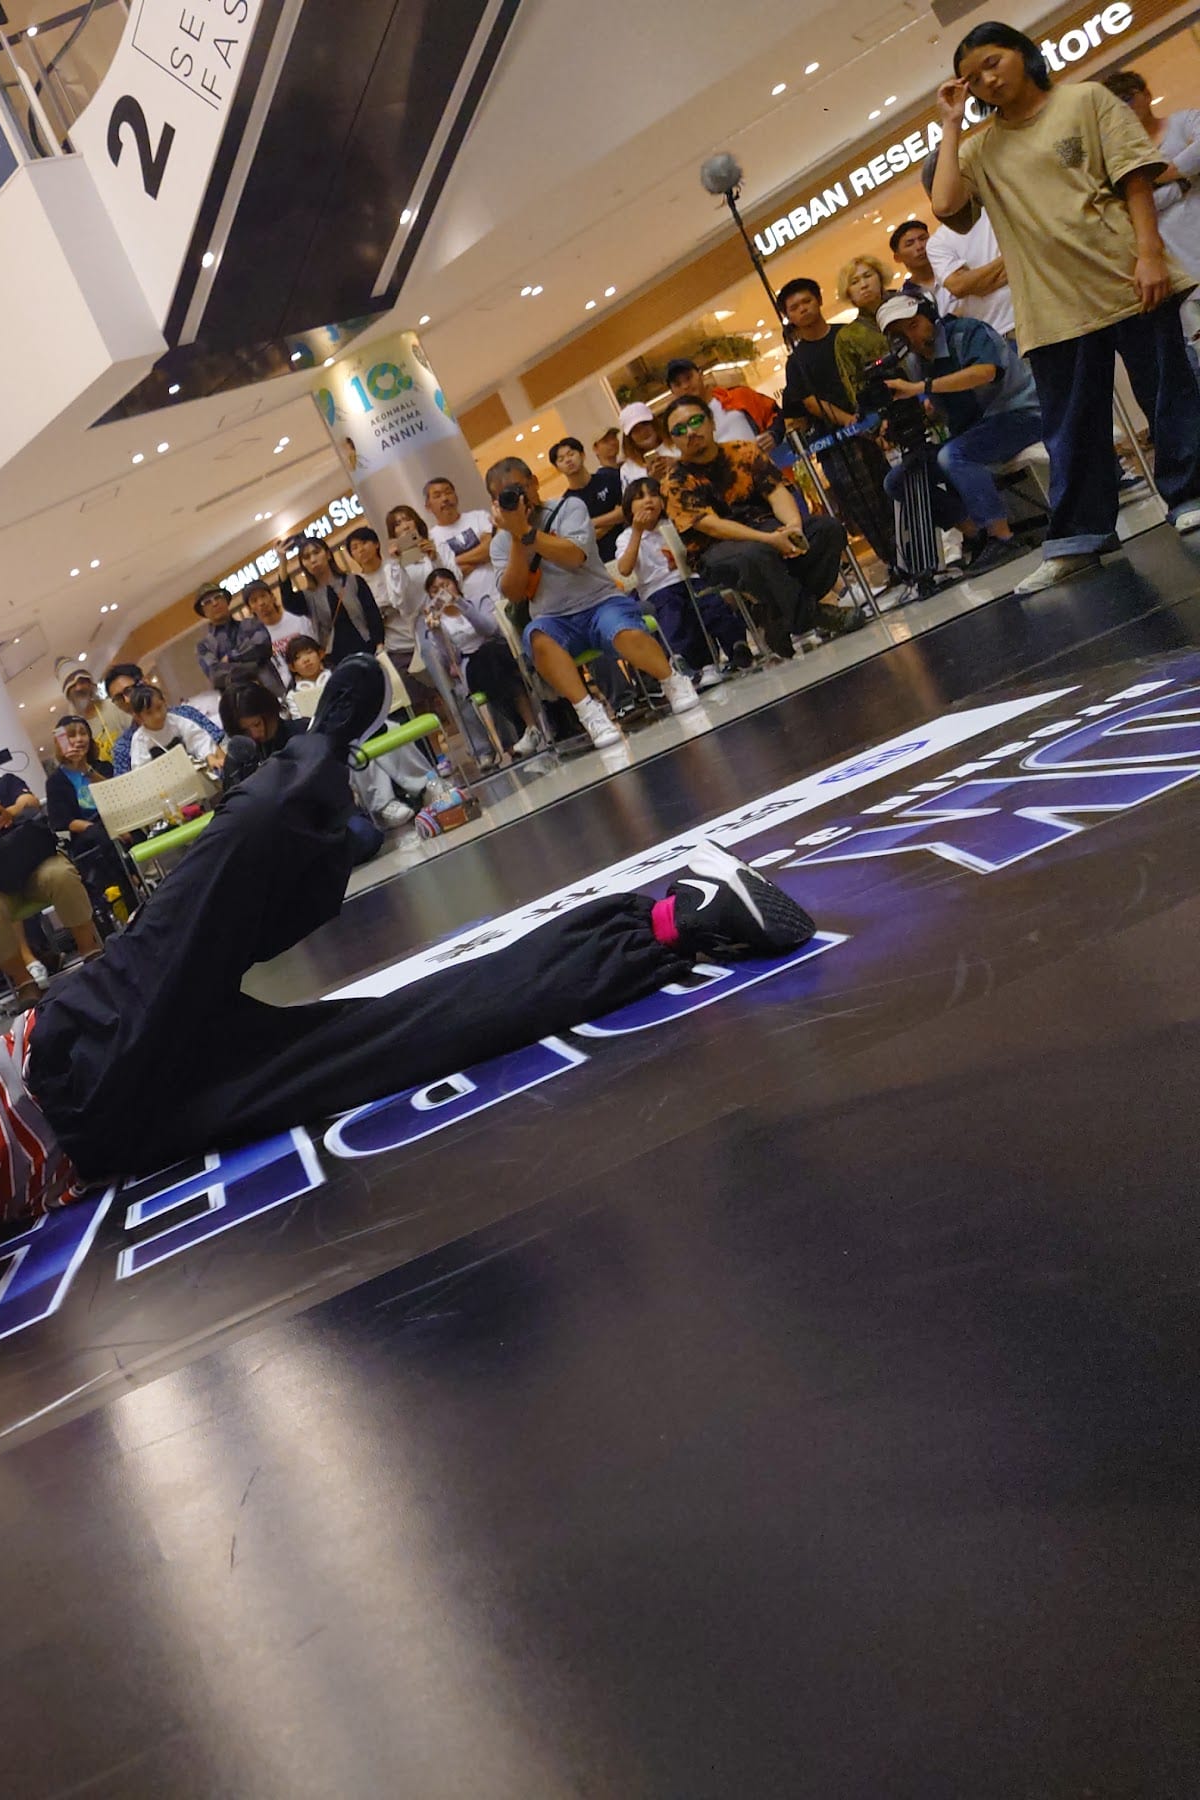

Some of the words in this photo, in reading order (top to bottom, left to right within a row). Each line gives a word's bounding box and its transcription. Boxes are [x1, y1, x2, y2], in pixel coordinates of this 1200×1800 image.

[170, 0, 213, 78] SE
[107, 94, 176, 201] 2
[753, 182, 850, 257] URBAN
[848, 95, 997, 198] RESEAC
[1040, 1, 1134, 74] tore
[370, 399, 417, 426] AEONMALL
[374, 410, 422, 436] OKAYAMA
[380, 420, 429, 451] ANNIV.
[255, 514, 333, 576] RECH
[329, 493, 364, 527] Sto
[860, 678, 1176, 815] Breakin
